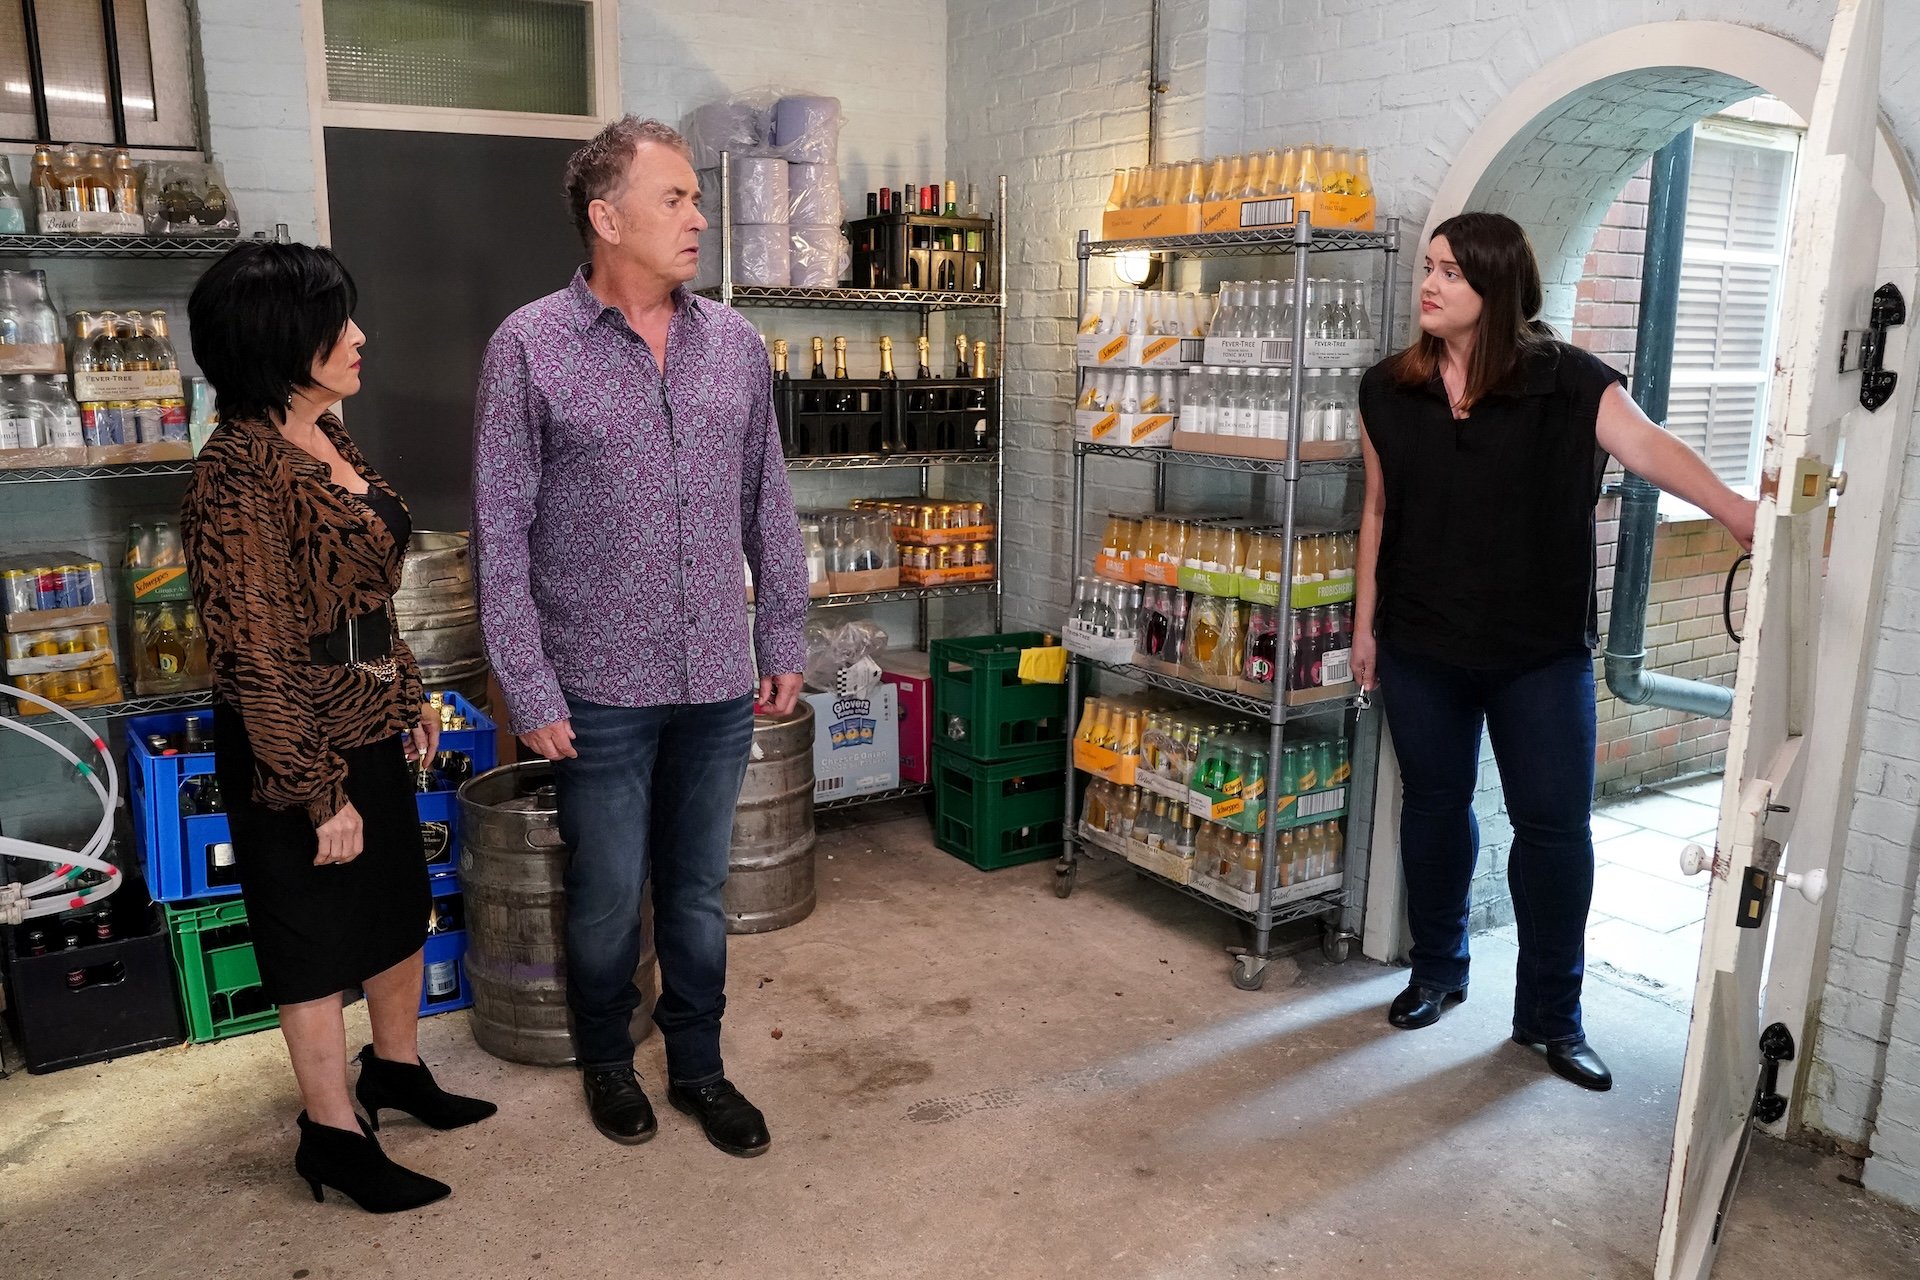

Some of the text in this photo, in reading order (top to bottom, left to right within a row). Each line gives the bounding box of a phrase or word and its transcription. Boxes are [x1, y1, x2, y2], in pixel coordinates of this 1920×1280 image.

[1102, 340, 1124, 359] Schweppes
[1142, 341, 1167, 359] Schweppes
[1221, 340, 1256, 348] FEVER-TREE
[1314, 340, 1347, 348] FEVER-TREE
[1132, 420, 1158, 438] Schweppes
[136, 571, 169, 593] Schweppes
[1258, 583, 1279, 596] APPLE
[833, 700, 870, 714] Glovers
[1216, 802, 1240, 816] Schweppes
